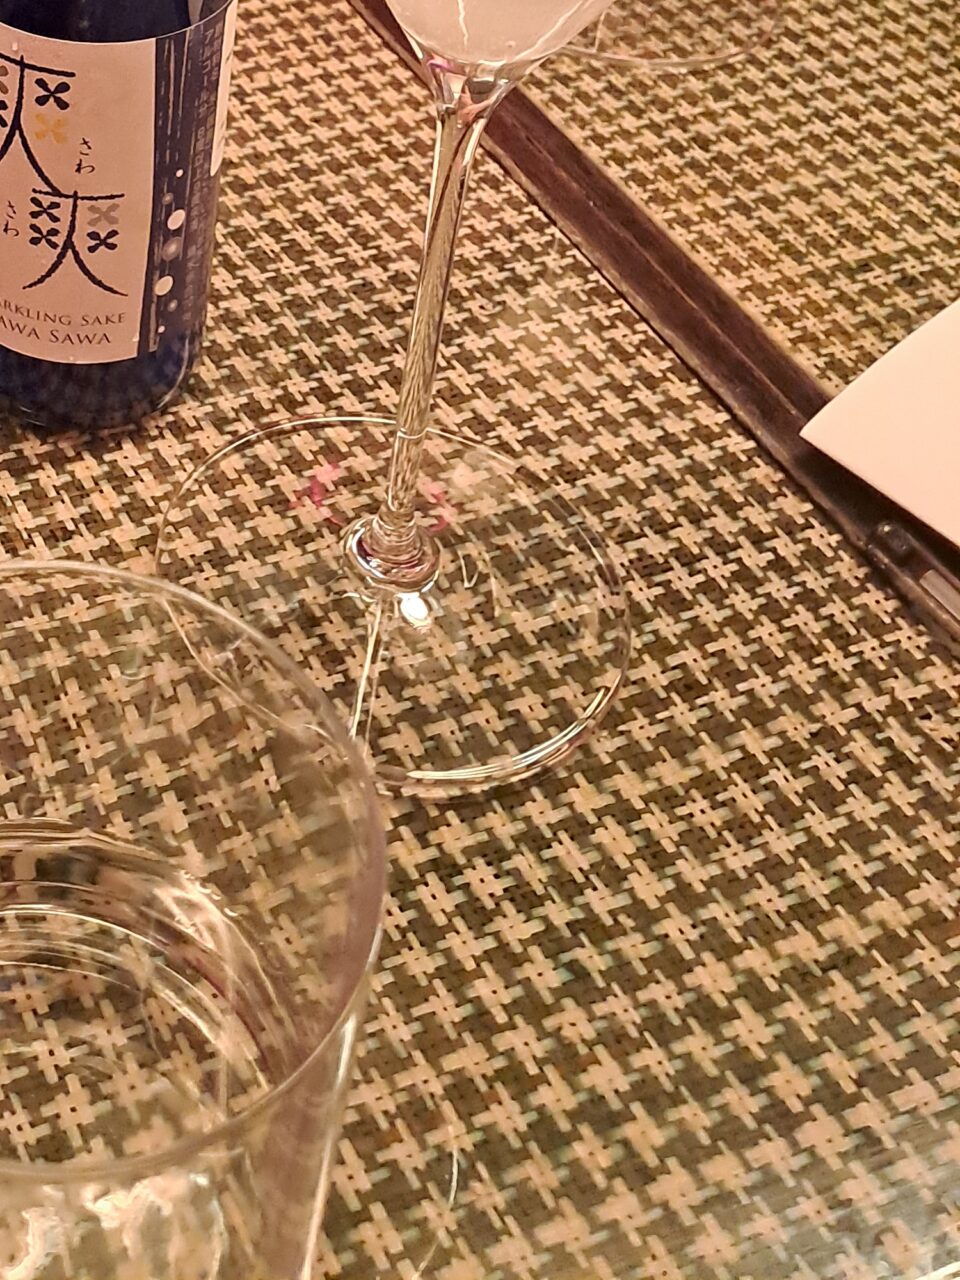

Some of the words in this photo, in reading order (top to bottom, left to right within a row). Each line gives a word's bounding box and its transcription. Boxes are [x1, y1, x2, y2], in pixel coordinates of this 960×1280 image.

[74, 136, 96, 175] さわ
[2, 199, 20, 238] さわ
[80, 312, 127, 327] SAKE
[48, 328, 112, 346] SAWA
